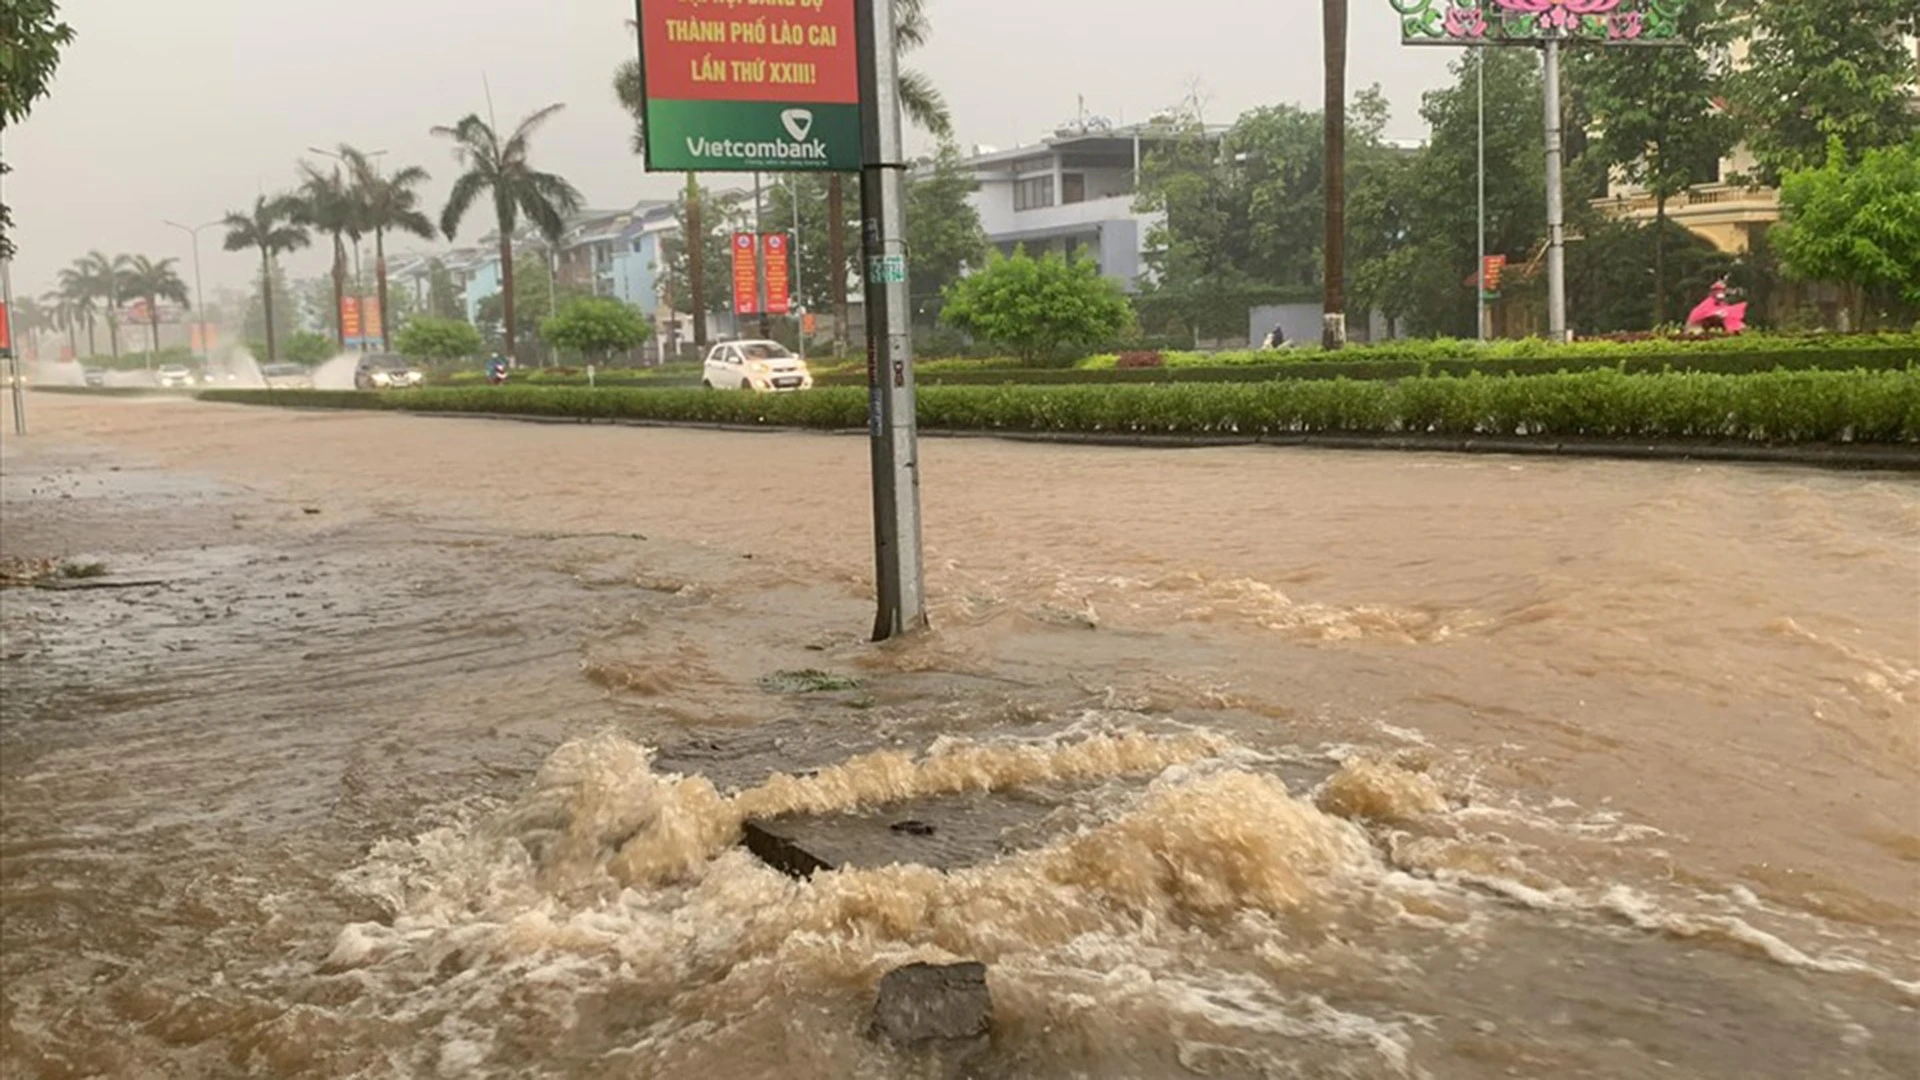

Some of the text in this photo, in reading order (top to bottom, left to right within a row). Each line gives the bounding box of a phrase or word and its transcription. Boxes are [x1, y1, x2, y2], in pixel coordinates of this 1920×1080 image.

[666, 16, 836, 47] THÀNH PHỐ LÀO CAI
[731, 57, 766, 82] THỨ
[770, 63, 816, 84] XXIII!
[687, 137, 827, 159] Vietcombank
